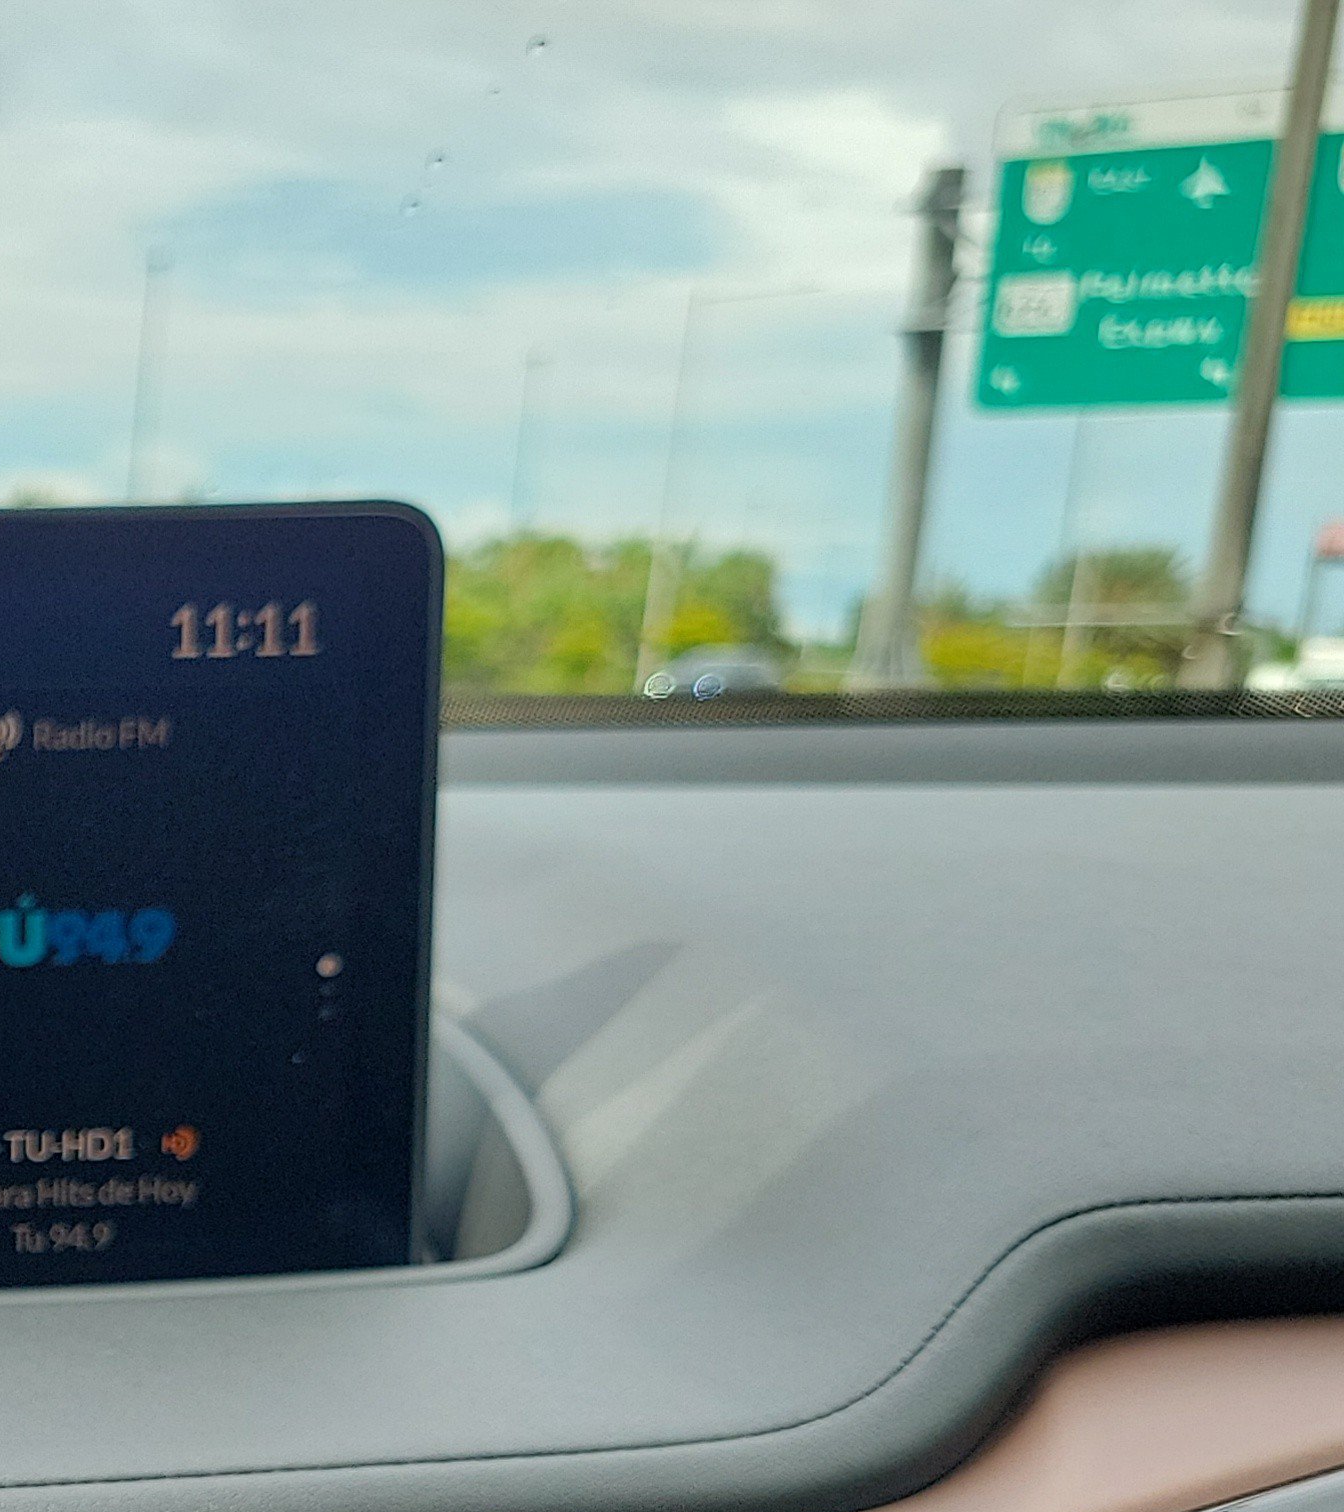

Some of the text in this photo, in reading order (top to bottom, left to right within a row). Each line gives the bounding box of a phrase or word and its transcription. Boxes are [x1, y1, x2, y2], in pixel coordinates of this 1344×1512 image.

[170, 602, 320, 658] 11:11
[32, 716, 172, 751] Radio FM
[37, 1176, 96, 1206] Hits
[99, 1177, 137, 1205] de
[139, 1175, 197, 1207] Hoy
